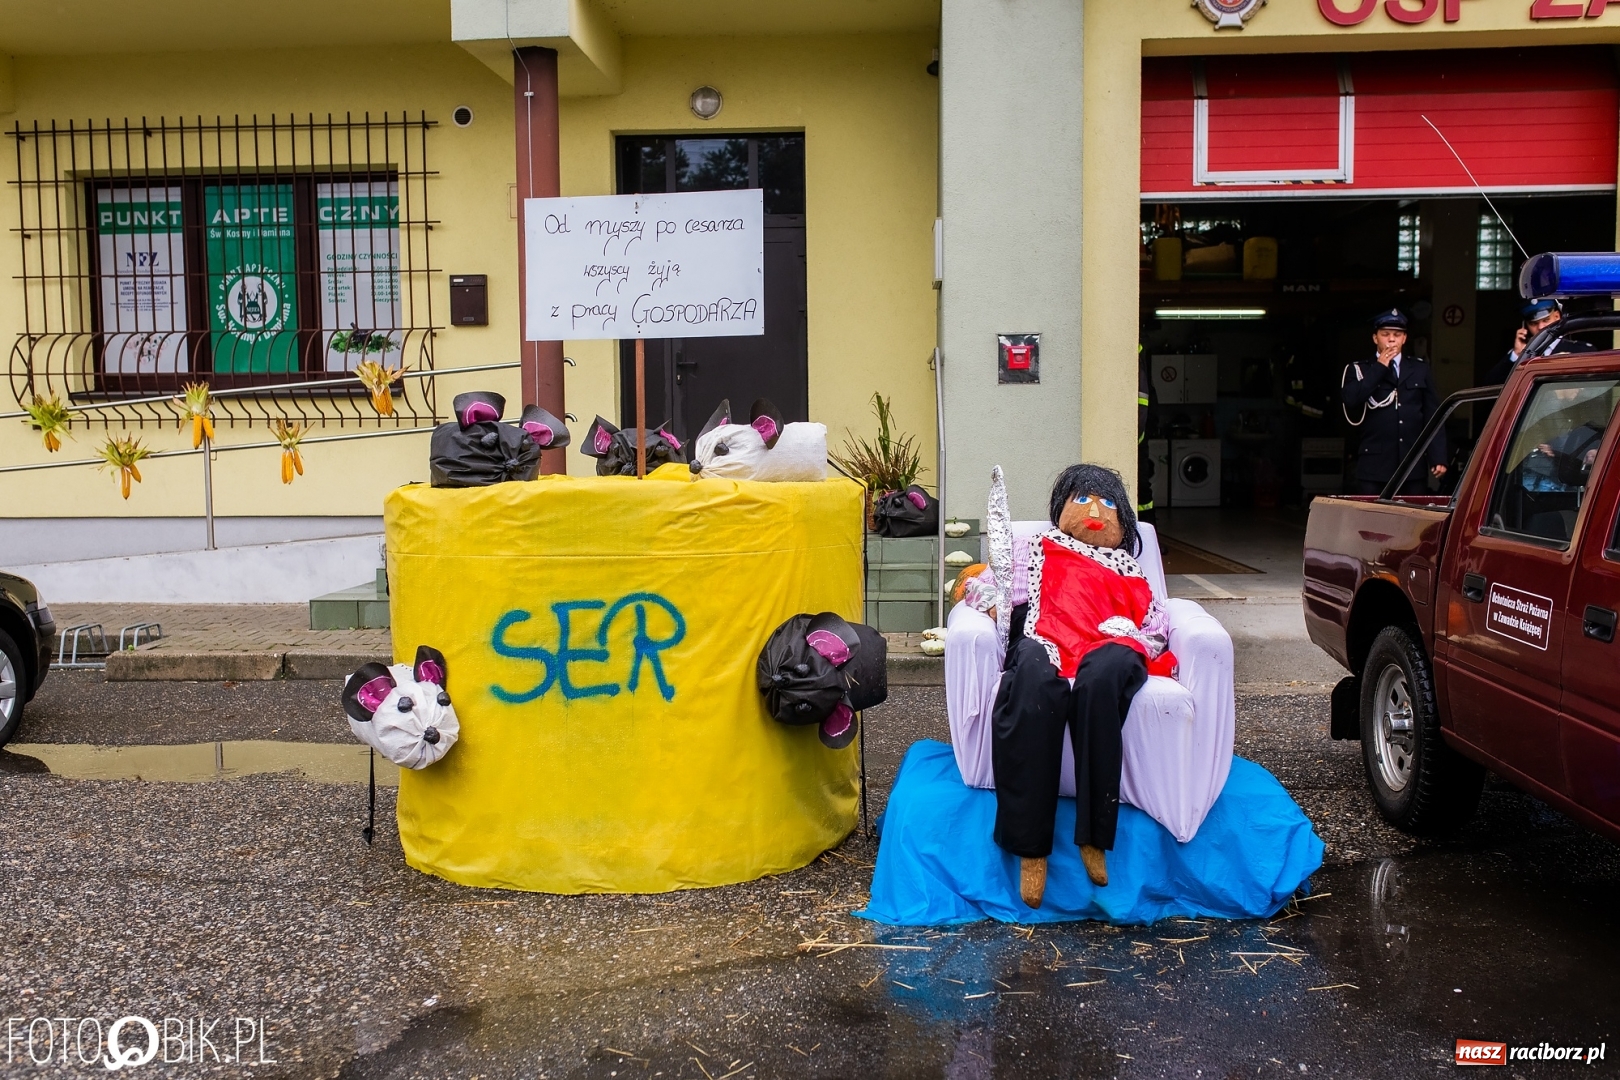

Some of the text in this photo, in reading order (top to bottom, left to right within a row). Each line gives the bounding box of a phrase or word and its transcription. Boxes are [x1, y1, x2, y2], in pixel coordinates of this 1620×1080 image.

[101, 205, 399, 226] PUNKT APTE CZNY
[544, 213, 745, 256] Od myszy po cesarza
[126, 251, 159, 267] NFZ
[583, 259, 682, 297] wszyscy żyją
[1282, 284, 1320, 292] MAN
[549, 293, 757, 331] z pracy GOSPODARZA
[1493, 611, 1498, 622] w
[1515, 599, 1529, 614] Straż
[1529, 602, 1549, 620] Pożarna
[489, 591, 687, 704] SER
